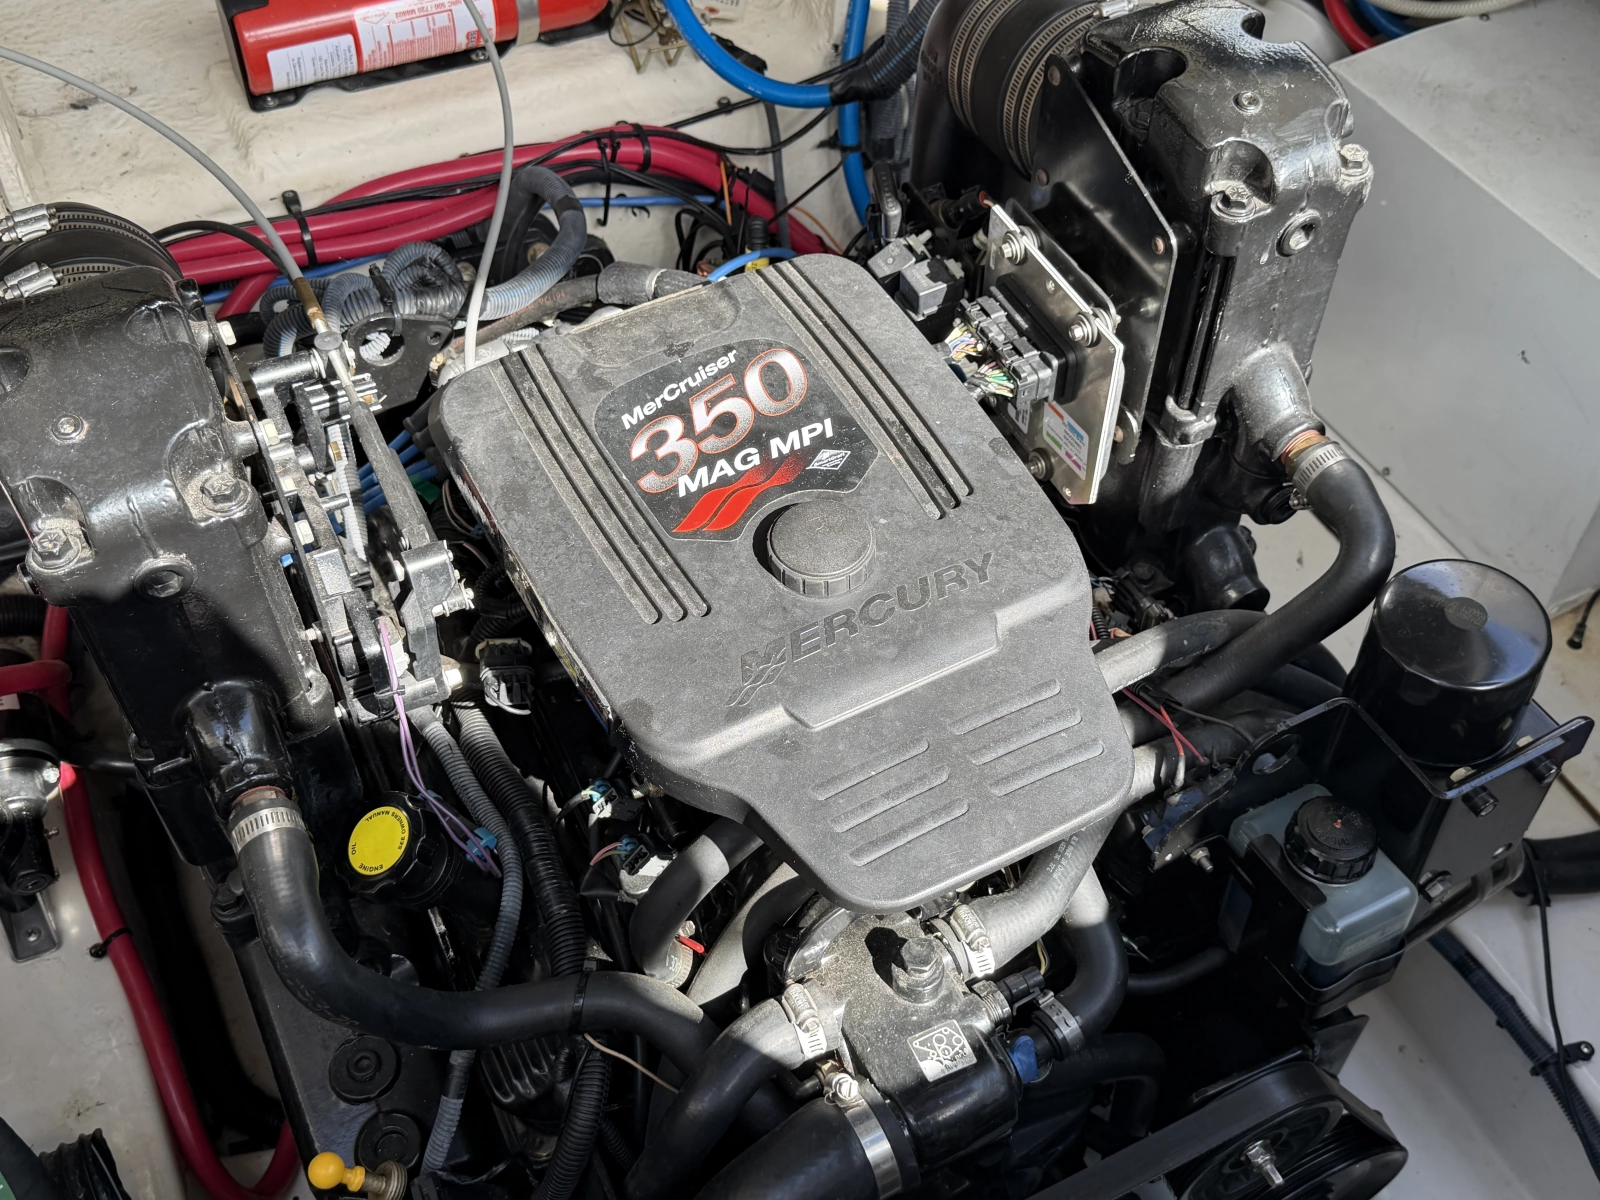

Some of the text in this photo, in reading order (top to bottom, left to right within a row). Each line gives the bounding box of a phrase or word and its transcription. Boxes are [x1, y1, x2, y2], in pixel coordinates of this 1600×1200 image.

[621, 350, 737, 430] MerCruiser
[630, 348, 808, 494] 350
[677, 418, 833, 498] MAG MPI
[725, 551, 993, 706] MERCURY
[358, 862, 384, 872] ENGINE
[364, 810, 406, 850] SEE OWNERS MANUAL
